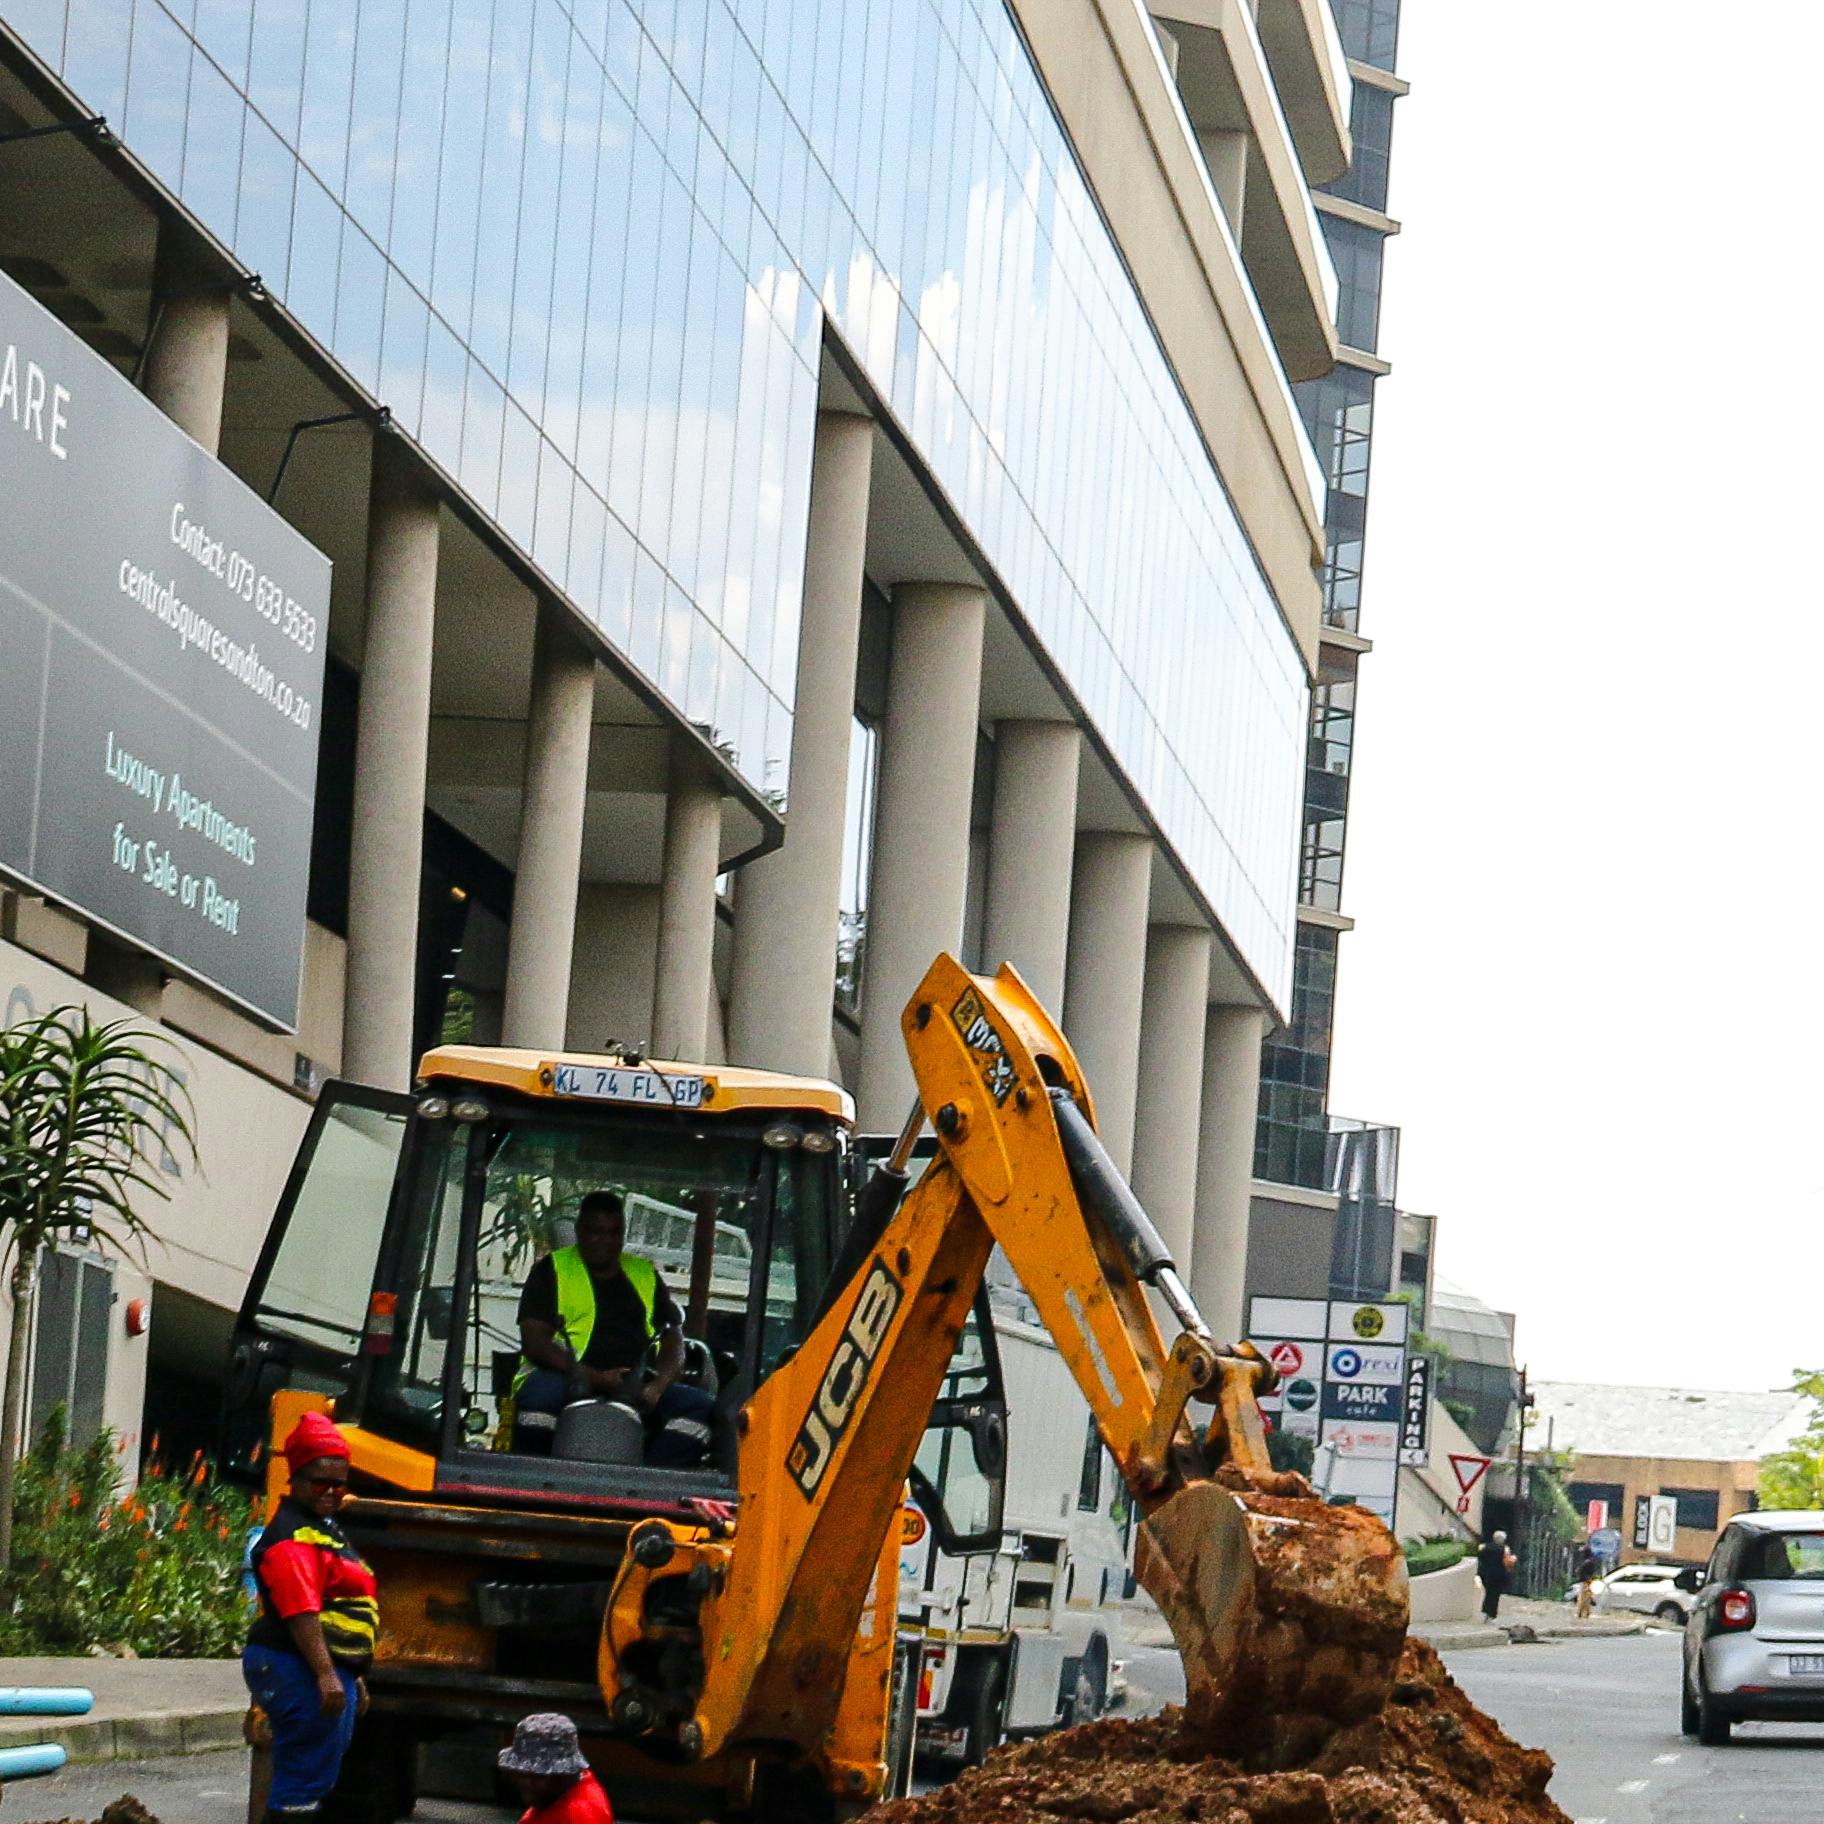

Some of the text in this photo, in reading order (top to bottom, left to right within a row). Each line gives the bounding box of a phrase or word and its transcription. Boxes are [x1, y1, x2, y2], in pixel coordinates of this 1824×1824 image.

[227, 551, 255, 602] 073
[255, 574, 283, 625] 633
[119, 558, 312, 730] centralsquaresandton.co.za
[105, 730, 257, 867] Luxury Apartments
[112, 821, 241, 936] for Sale or Rent
[556, 1067, 699, 1101] KL 74 FL GP
[800, 1268, 898, 1490] JCB
[1336, 1385, 1388, 1404] PARK
[1404, 1359, 1424, 1448] PARKING
